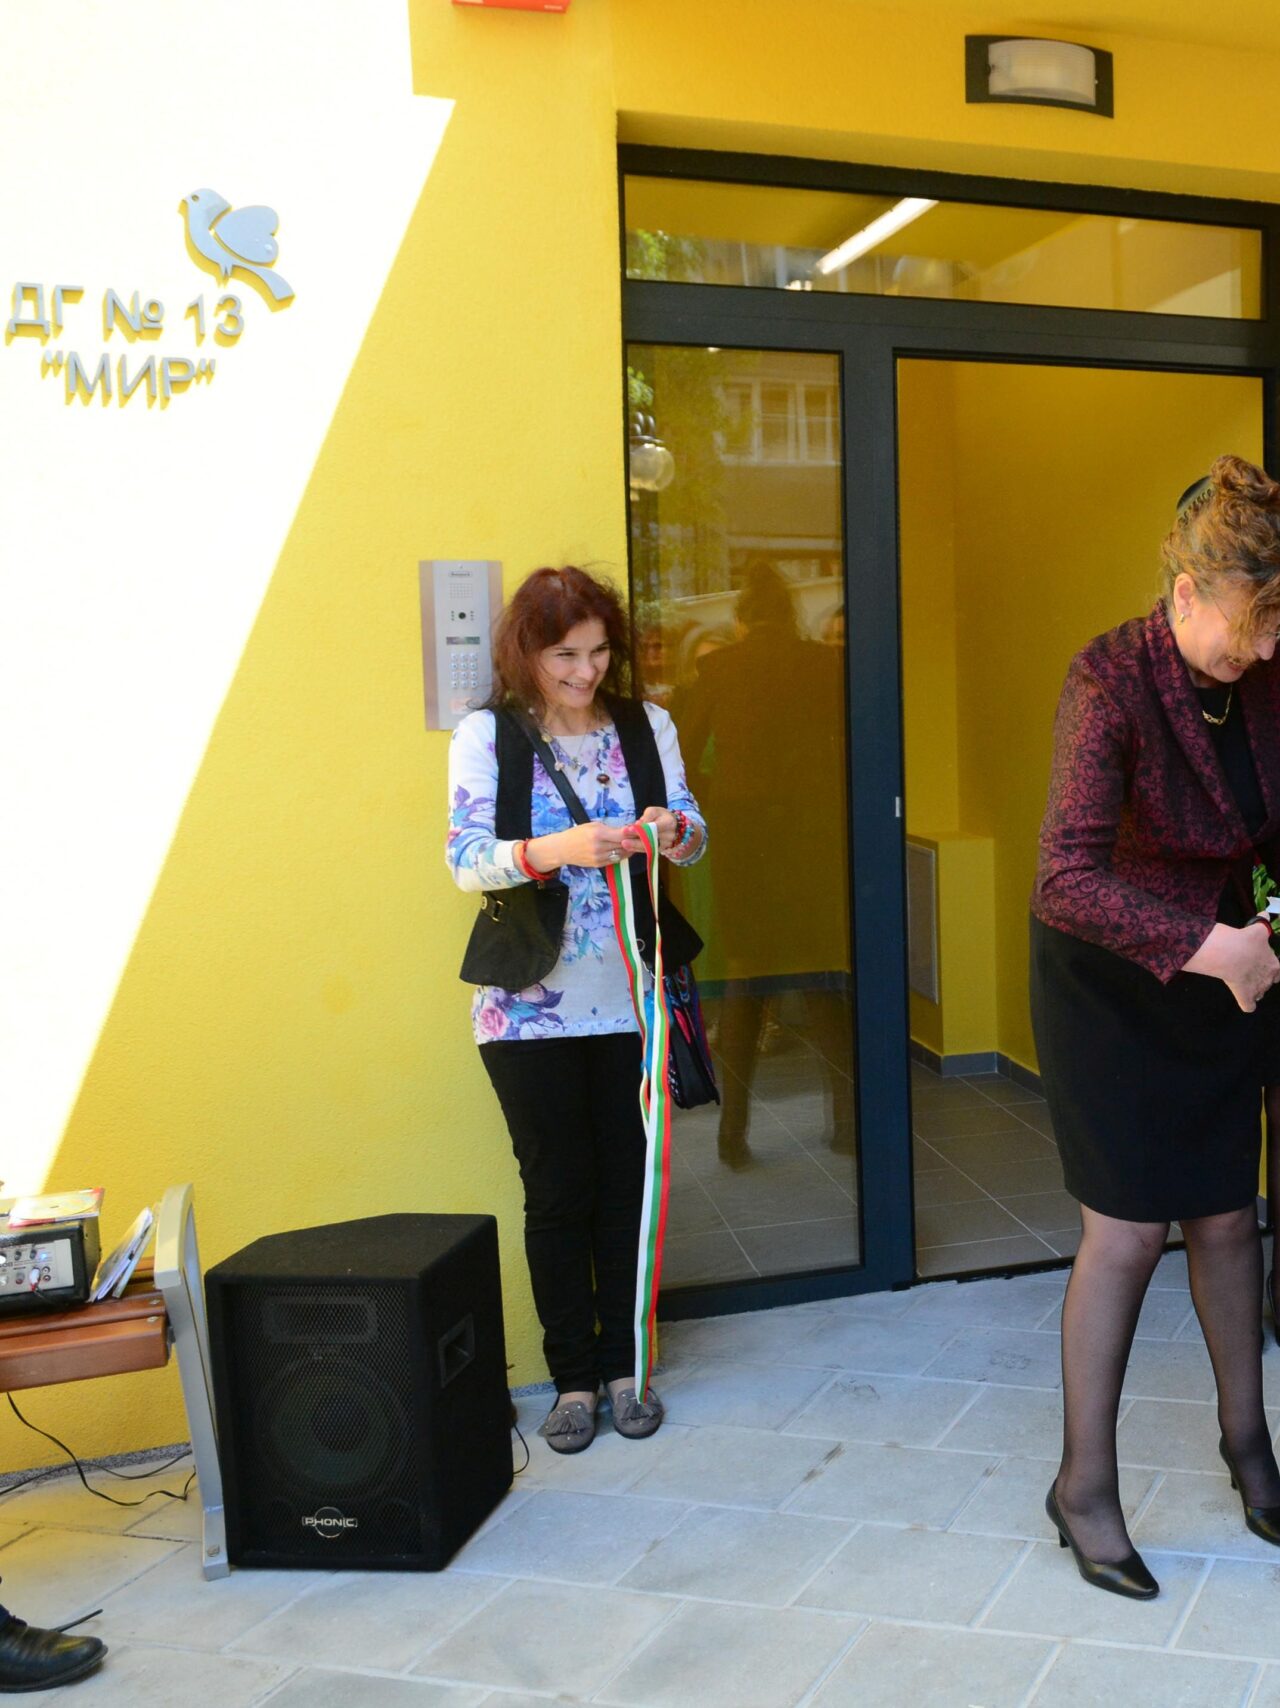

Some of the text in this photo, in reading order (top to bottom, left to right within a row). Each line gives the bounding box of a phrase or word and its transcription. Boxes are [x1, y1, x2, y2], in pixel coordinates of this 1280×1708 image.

[7, 281, 245, 343] ДГ № 13
[303, 1516, 357, 1528] PHONIC
